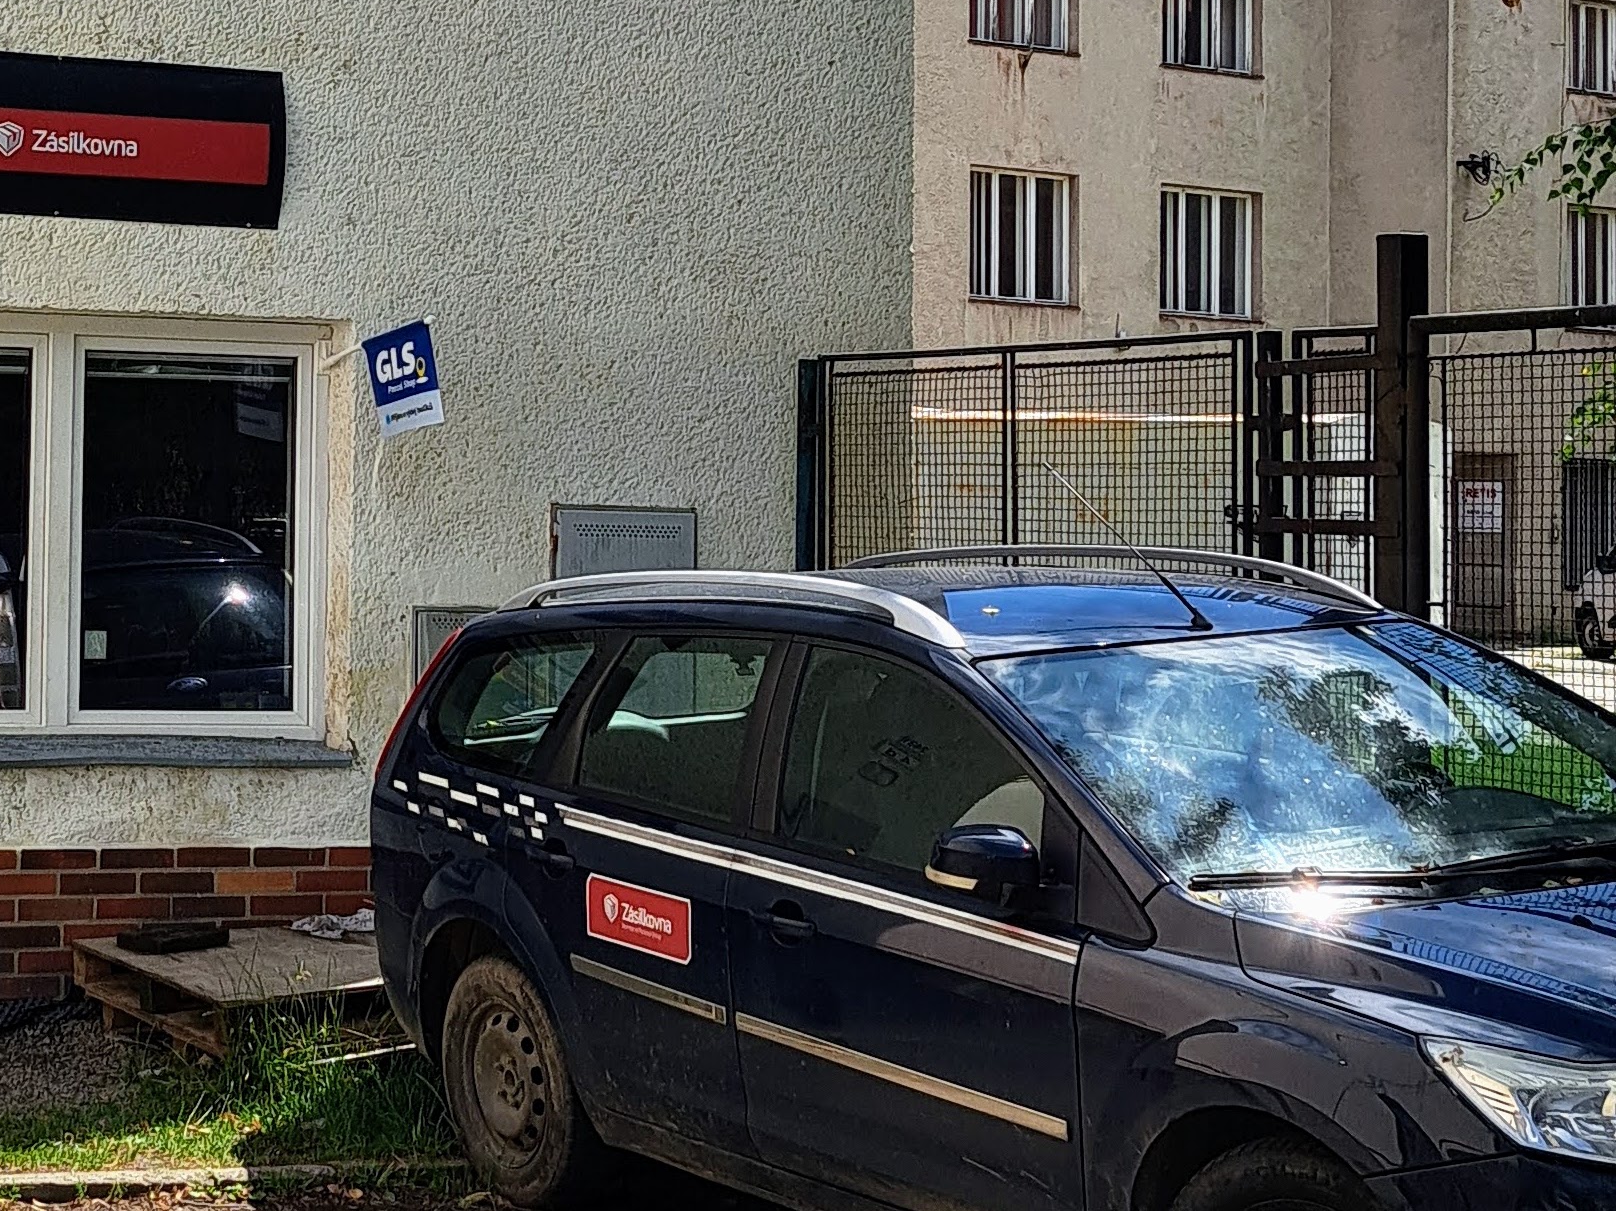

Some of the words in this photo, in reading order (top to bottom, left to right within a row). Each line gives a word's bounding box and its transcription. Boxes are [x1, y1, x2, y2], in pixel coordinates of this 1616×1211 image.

[31, 129, 138, 157] Zásilkovna
[376, 341, 415, 384] GLS
[621, 902, 672, 935] Zásilkovna
